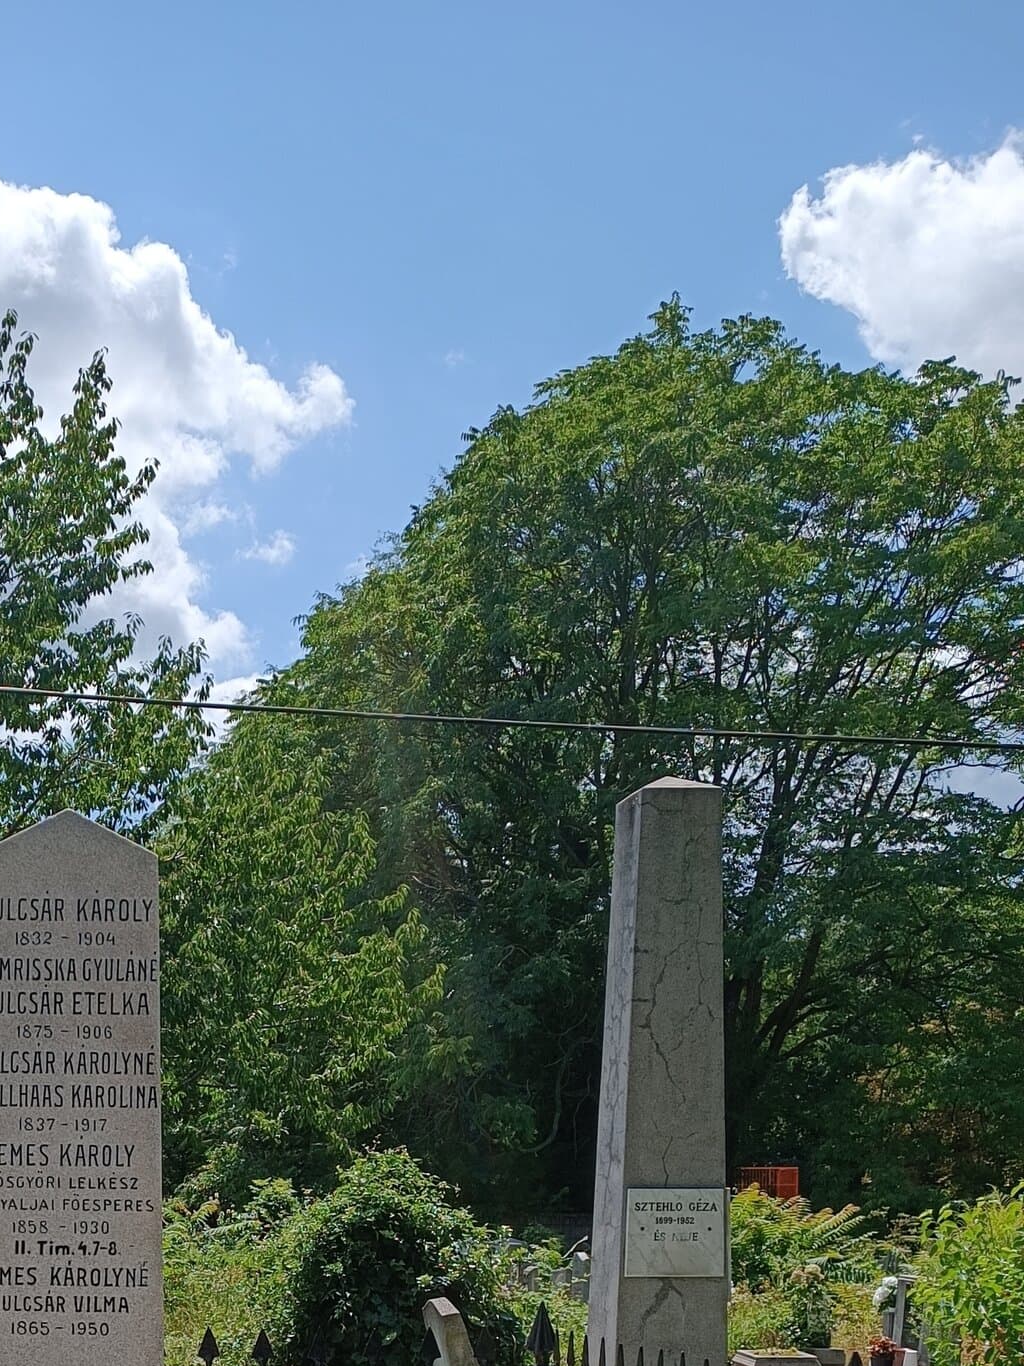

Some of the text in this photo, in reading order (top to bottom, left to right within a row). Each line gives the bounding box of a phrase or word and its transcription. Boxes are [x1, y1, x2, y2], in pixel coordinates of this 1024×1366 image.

[76, 889, 153, 922] KÁROLY
[15, 931, 53, 946] 1832
[78, 931, 116, 946] 1904
[82, 950, 158, 983] GYULÁNÉ
[72, 991, 150, 1016] ETELKA
[17, 1025, 53, 1039] 1875
[76, 1025, 113, 1039] 1906
[63, 1043, 156, 1075] KÁROLYNÉ
[71, 1084, 158, 1109] KAROLINA
[19, 1117, 55, 1132] 1837
[75, 1118, 108, 1132] 1917
[59, 1134, 136, 1168] KÁROLY
[69, 1171, 139, 1190] LELKÉSZ
[634, 1198, 718, 1212] SZTEHLO GÉZA
[12, 1220, 49, 1234] 1858
[73, 1220, 110, 1235] 1930
[653, 1229, 666, 1242] ÉS
[49, 1260, 149, 1288] KÁROLYNÉ
[74, 1296, 130, 1313] VILMA
[11, 1320, 50, 1336] 1865
[71, 1321, 110, 1336] 1950
